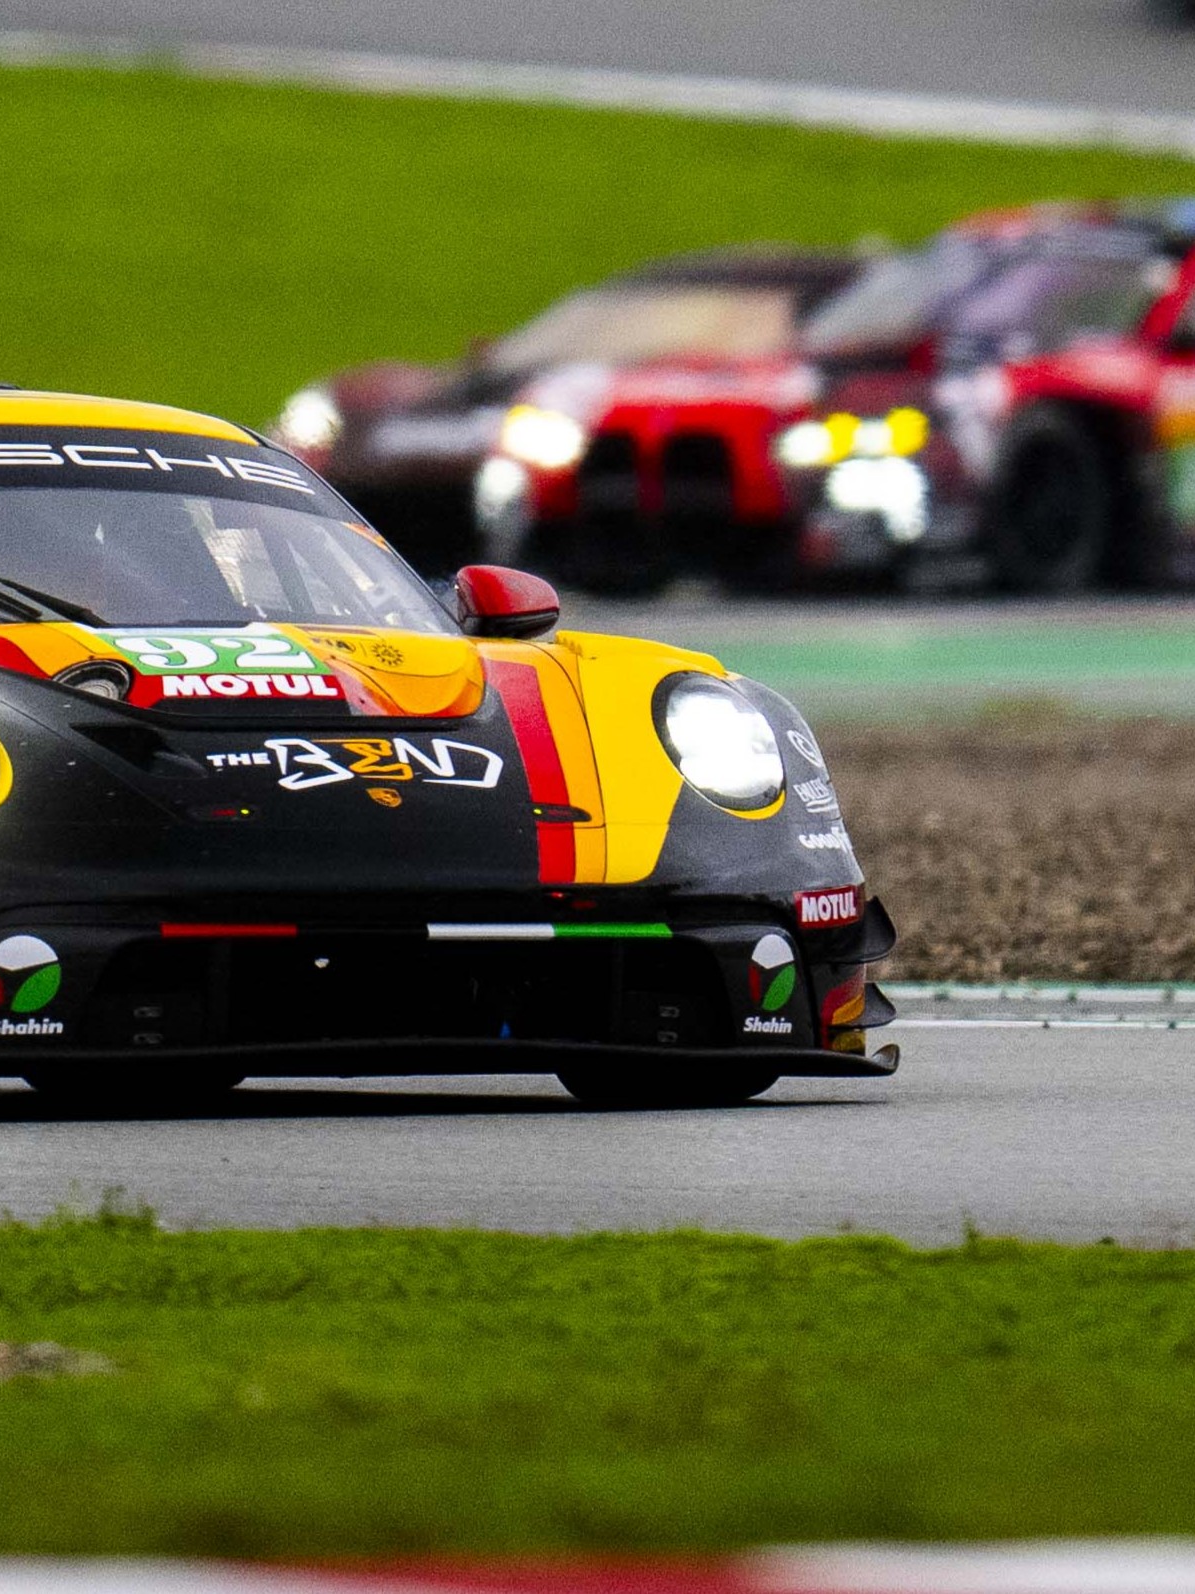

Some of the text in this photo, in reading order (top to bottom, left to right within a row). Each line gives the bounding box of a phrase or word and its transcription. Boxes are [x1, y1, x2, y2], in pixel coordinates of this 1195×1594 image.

[114, 634, 316, 670] 92
[162, 674, 338, 698] MOTUL
[206, 737, 504, 790] THE BEND
[801, 890, 857, 922] MOTUL
[743, 1016, 793, 1034] Shahin
